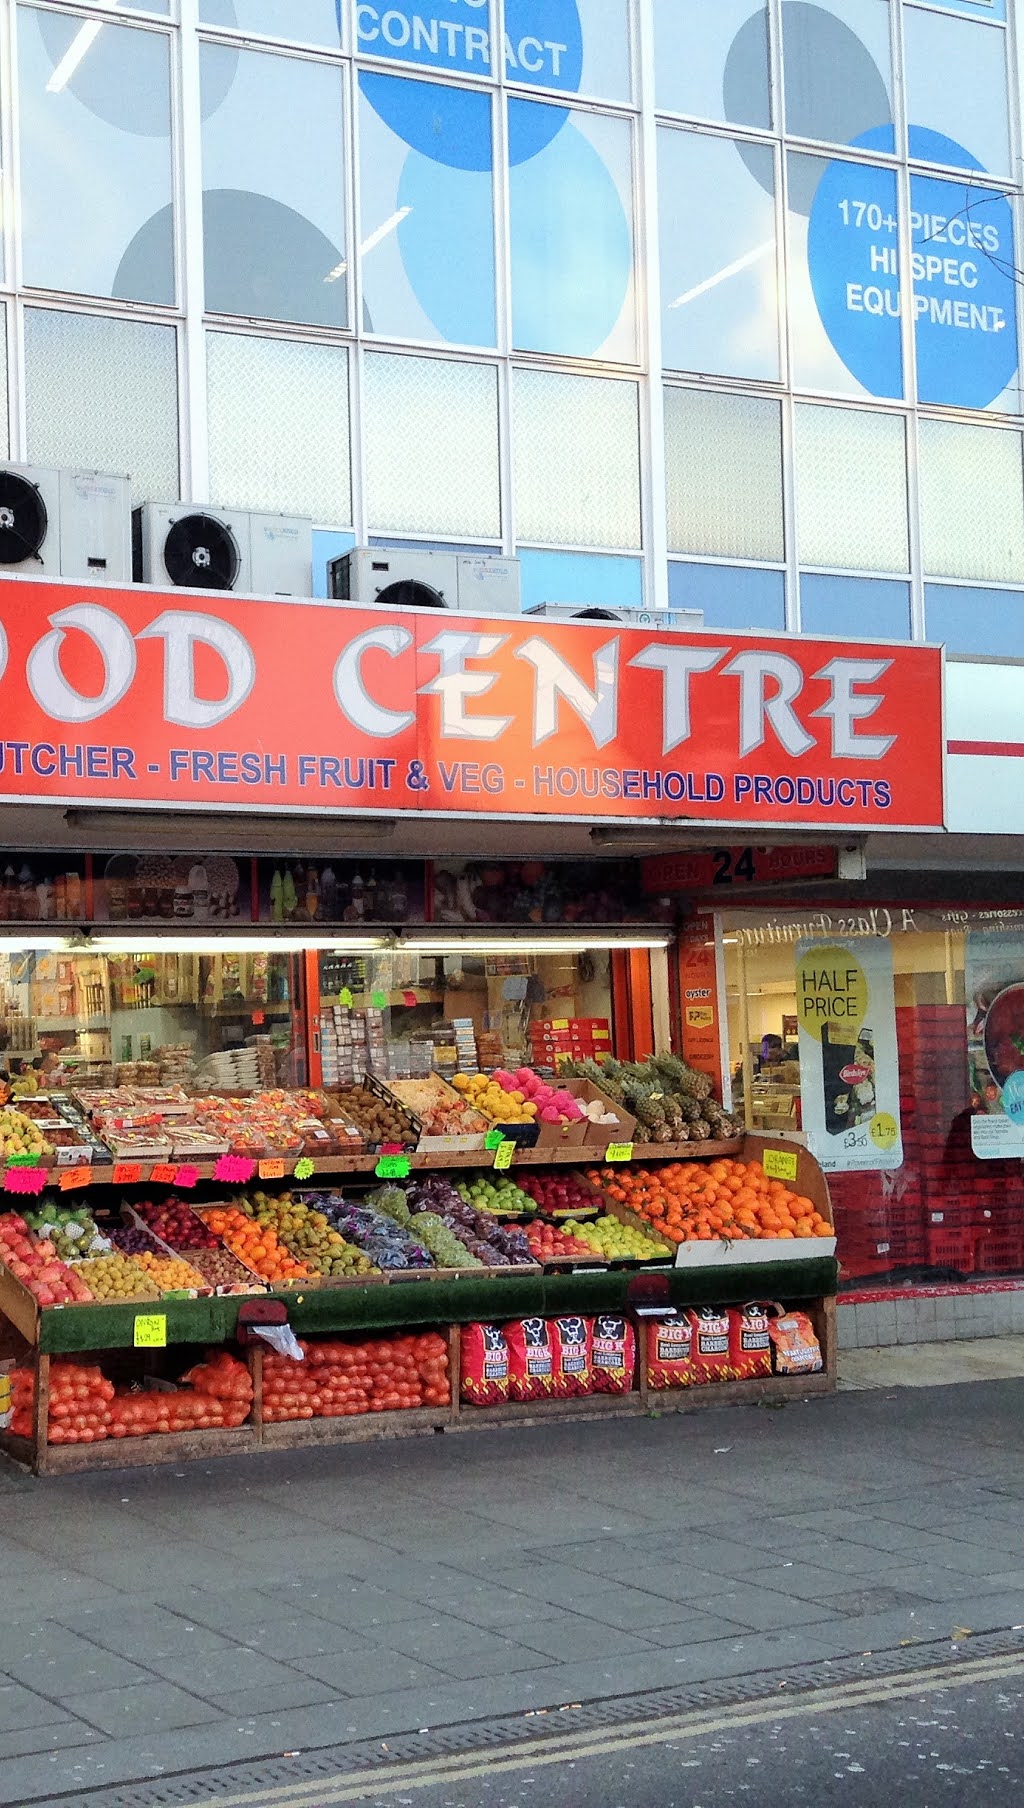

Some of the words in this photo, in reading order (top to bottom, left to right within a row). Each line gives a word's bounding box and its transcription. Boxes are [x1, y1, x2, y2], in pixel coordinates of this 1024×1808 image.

[357, 4, 568, 77] CONTRACT
[838, 199, 898, 233] 170+
[910, 211, 1000, 252] PIECES
[870, 245, 898, 276] HI
[912, 252, 979, 289] SPEC
[846, 283, 1006, 333] EQUPMENT
[332, 625, 898, 760] CENTRE
[170, 748, 287, 787] FRESH
[298, 754, 396, 791] FRUIT
[407, 760, 430, 792] &
[438, 761, 505, 795] VEG
[533, 764, 724, 802] HOUSEHOLD
[734, 773, 892, 809] PRODUCTS
[713, 847, 756, 885] 24
[685, 950, 710, 968] 24
[802, 969, 858, 992] HALF
[685, 988, 712, 1001] oyster
[804, 997, 858, 1017] PRICE
[657, 1326, 679, 1339] BIG
[698, 1319, 720, 1333] BIG
[741, 1318, 763, 1330] BIG
[527, 1347, 541, 1358] BIG
[561, 1344, 578, 1356] BIG
[593, 1340, 613, 1350] BIG
[485, 1350, 502, 1361] BIG
